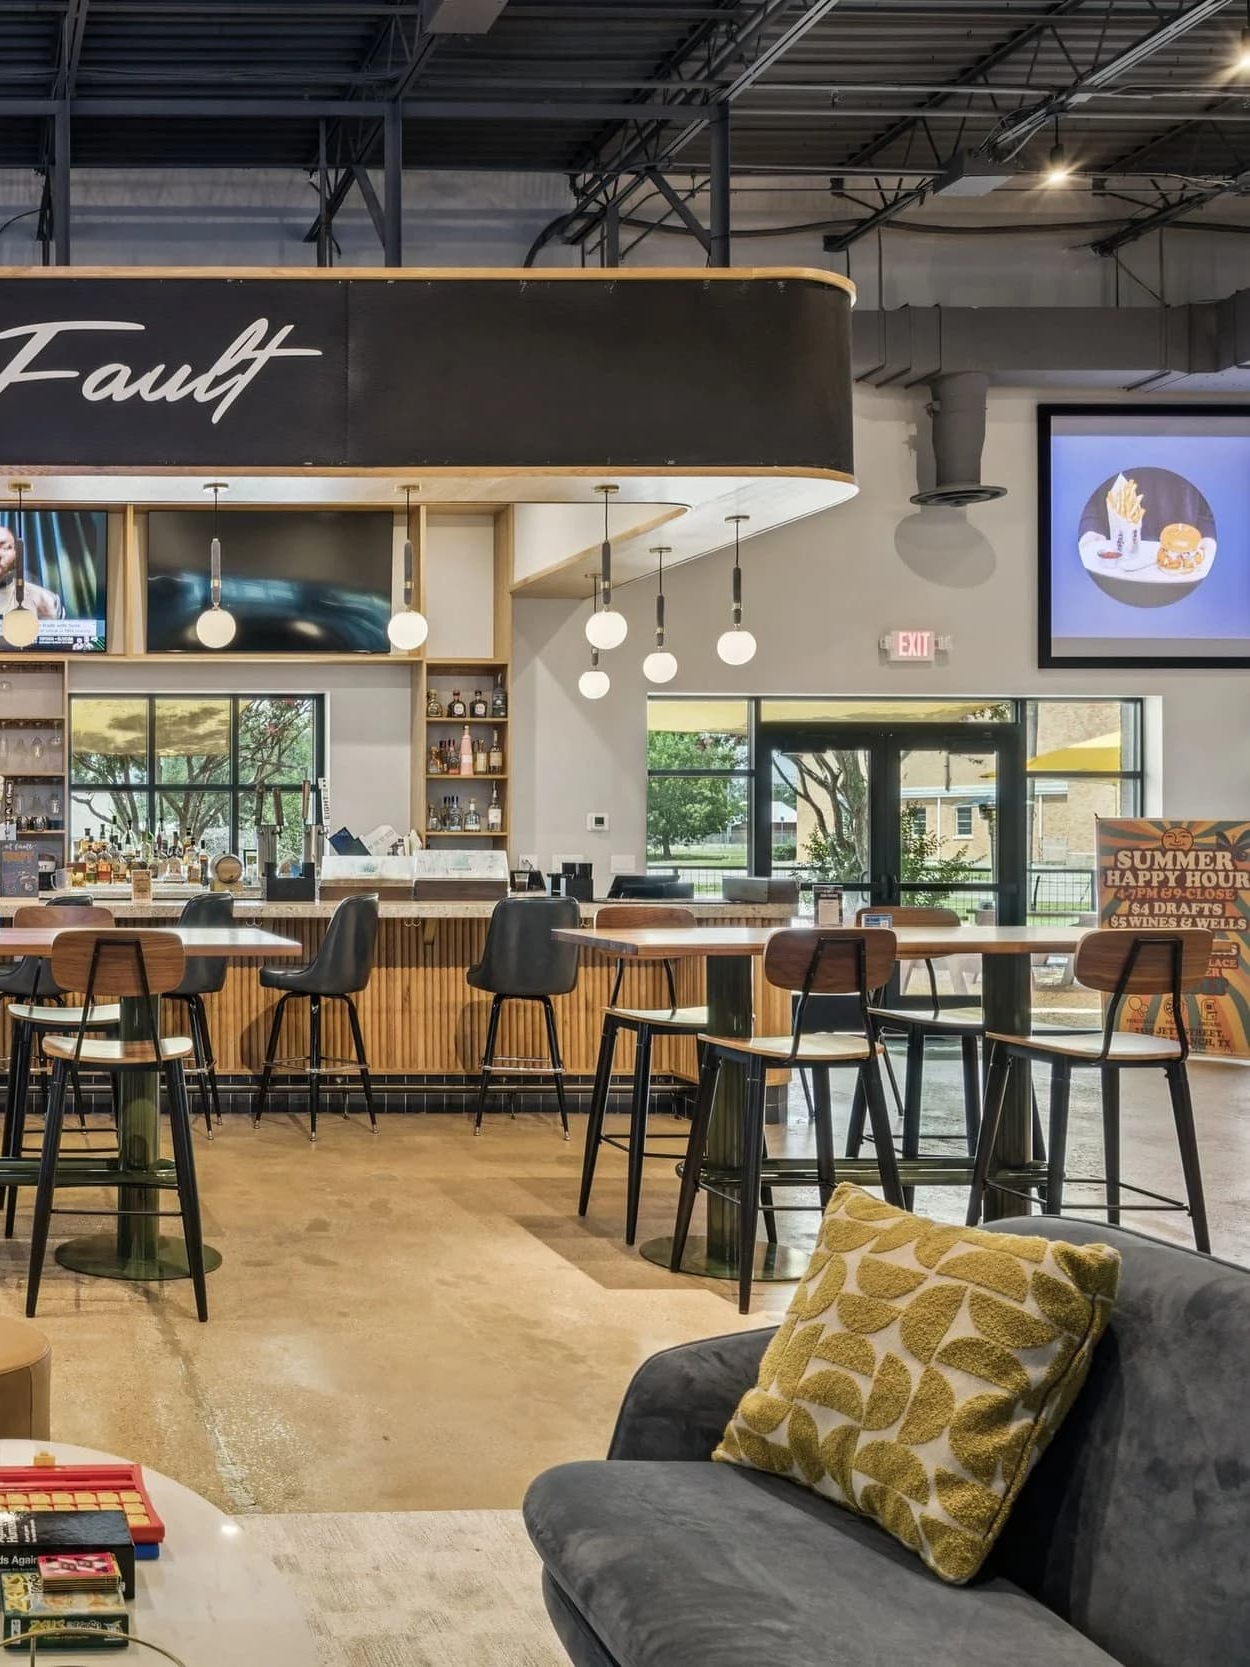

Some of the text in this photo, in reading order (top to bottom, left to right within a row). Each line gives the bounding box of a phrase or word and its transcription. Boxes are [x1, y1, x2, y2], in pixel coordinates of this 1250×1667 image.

[898, 631, 930, 657] EXIT
[1116, 850, 1234, 870] SUMMER
[1105, 870, 1250, 888] HAPPY HOUR
[1131, 901, 1223, 915] $4 DRAFTS
[1110, 915, 1247, 930] $5 WINES & WELLS
